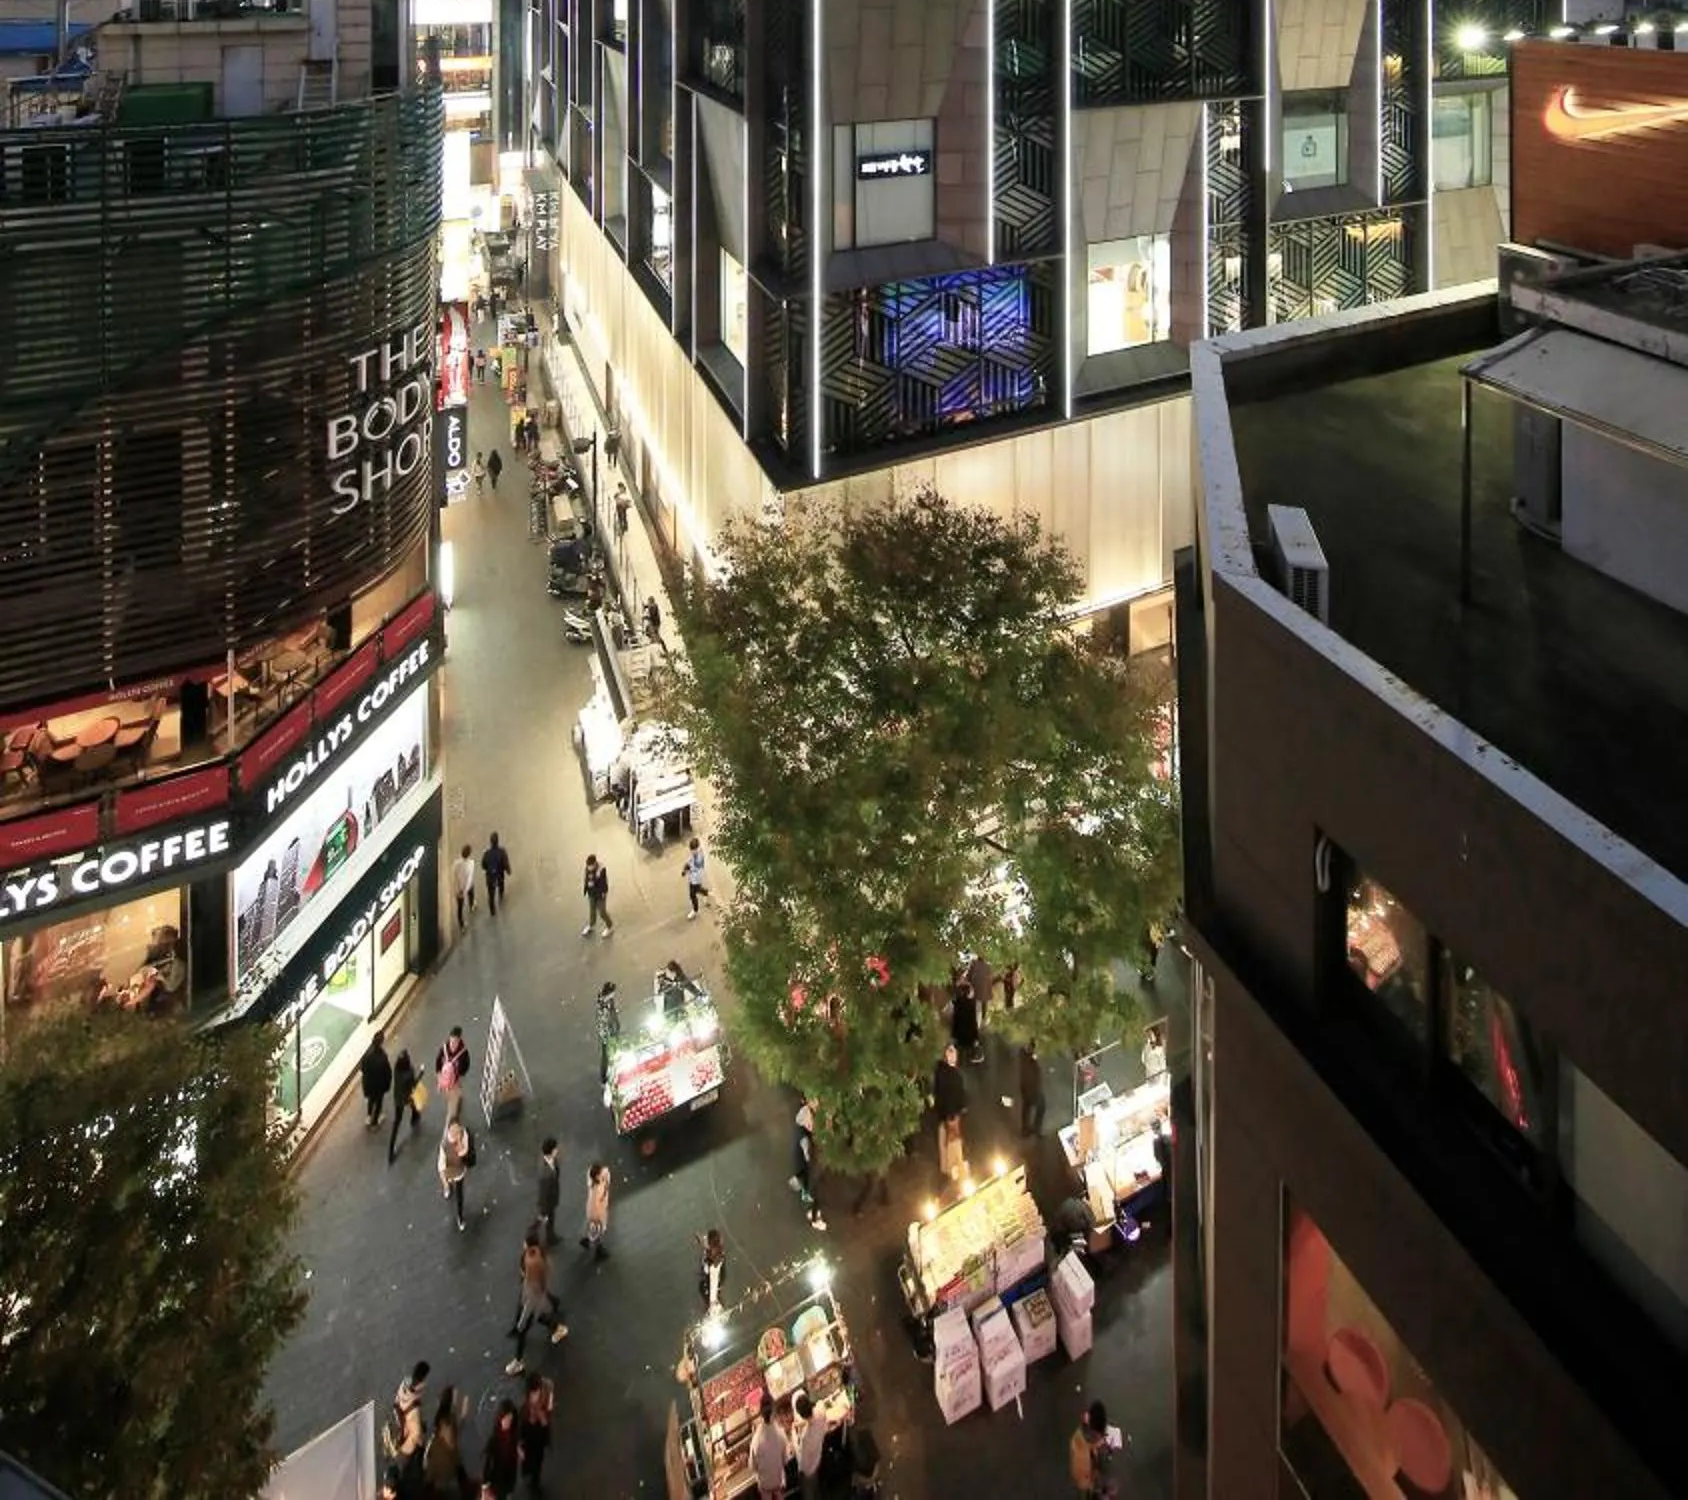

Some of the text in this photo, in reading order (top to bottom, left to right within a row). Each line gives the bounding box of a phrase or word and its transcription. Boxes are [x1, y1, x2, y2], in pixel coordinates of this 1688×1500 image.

[350, 322, 429, 392] THE
[328, 372, 431, 460] BODY
[447, 414, 461, 467] ALDO
[332, 416, 433, 515] SHOP
[267, 713, 353, 813] HOLLYS
[357, 639, 429, 722] COFFEE
[72, 821, 230, 893] COFFEE
[276, 973, 319, 1029] THE
[324, 900, 378, 981] BODY
[380, 845, 425, 912] SHOP
